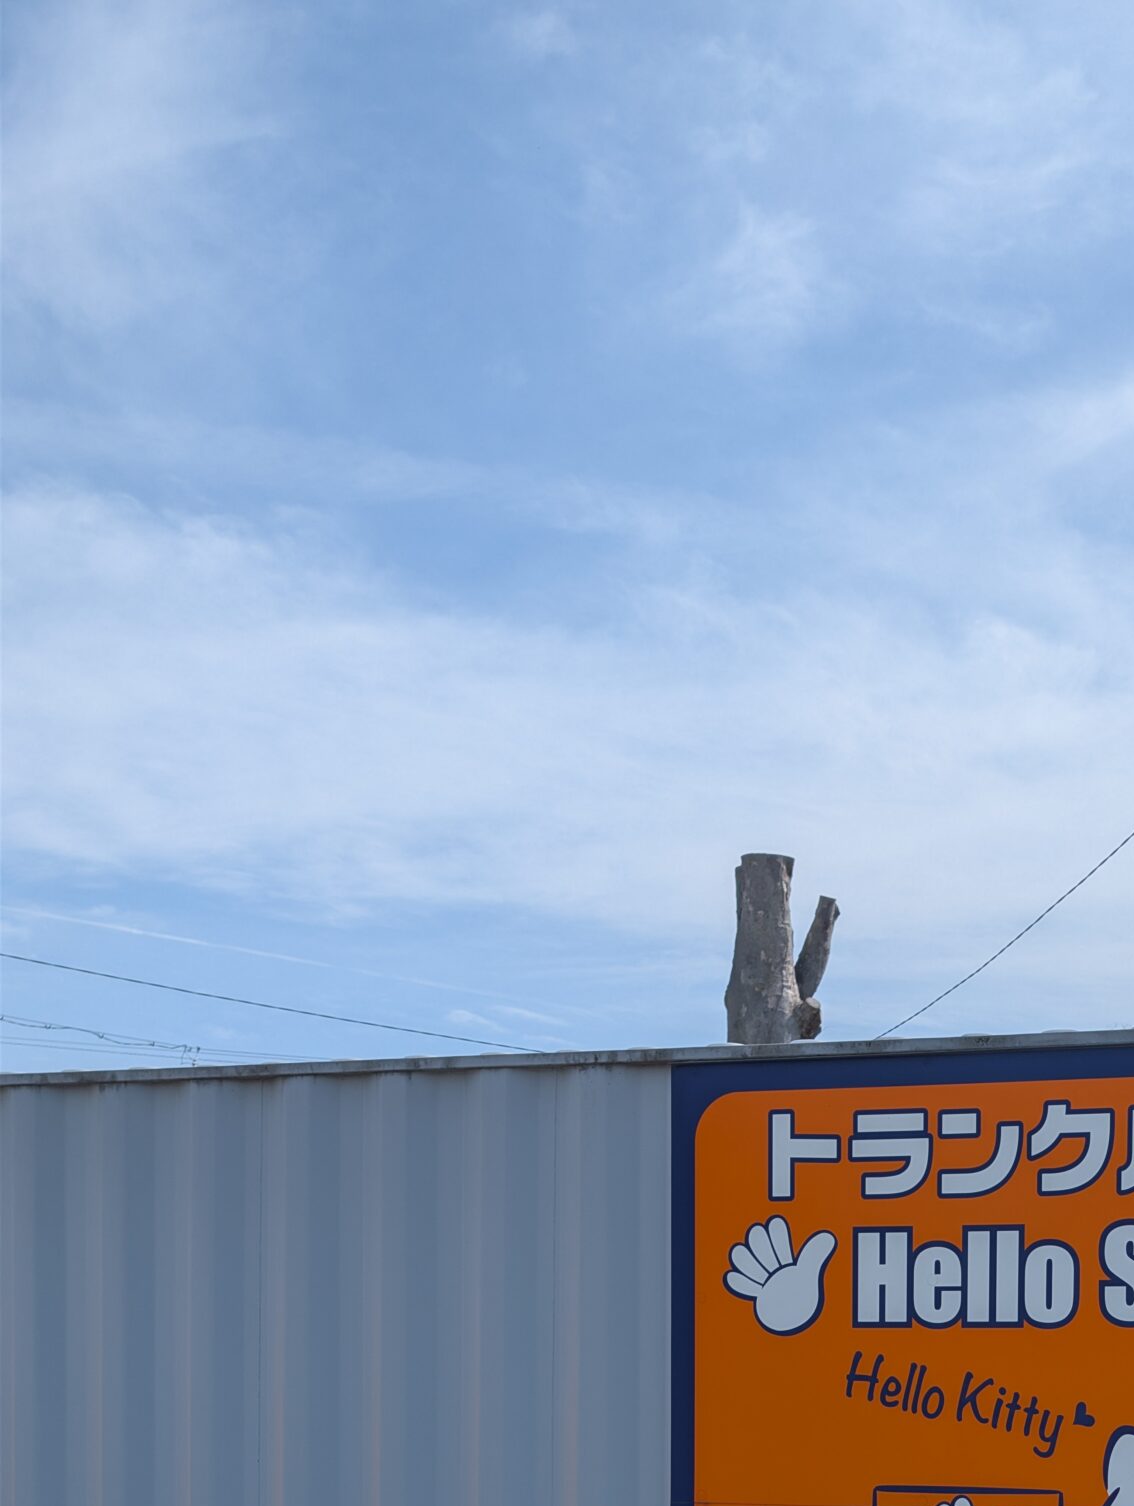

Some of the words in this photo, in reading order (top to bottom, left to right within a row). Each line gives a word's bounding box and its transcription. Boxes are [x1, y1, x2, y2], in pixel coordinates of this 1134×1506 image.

[852, 1224, 1079, 1329] Hello
[845, 1351, 946, 1420] Hello
[957, 1371, 1066, 1458] Kitty
